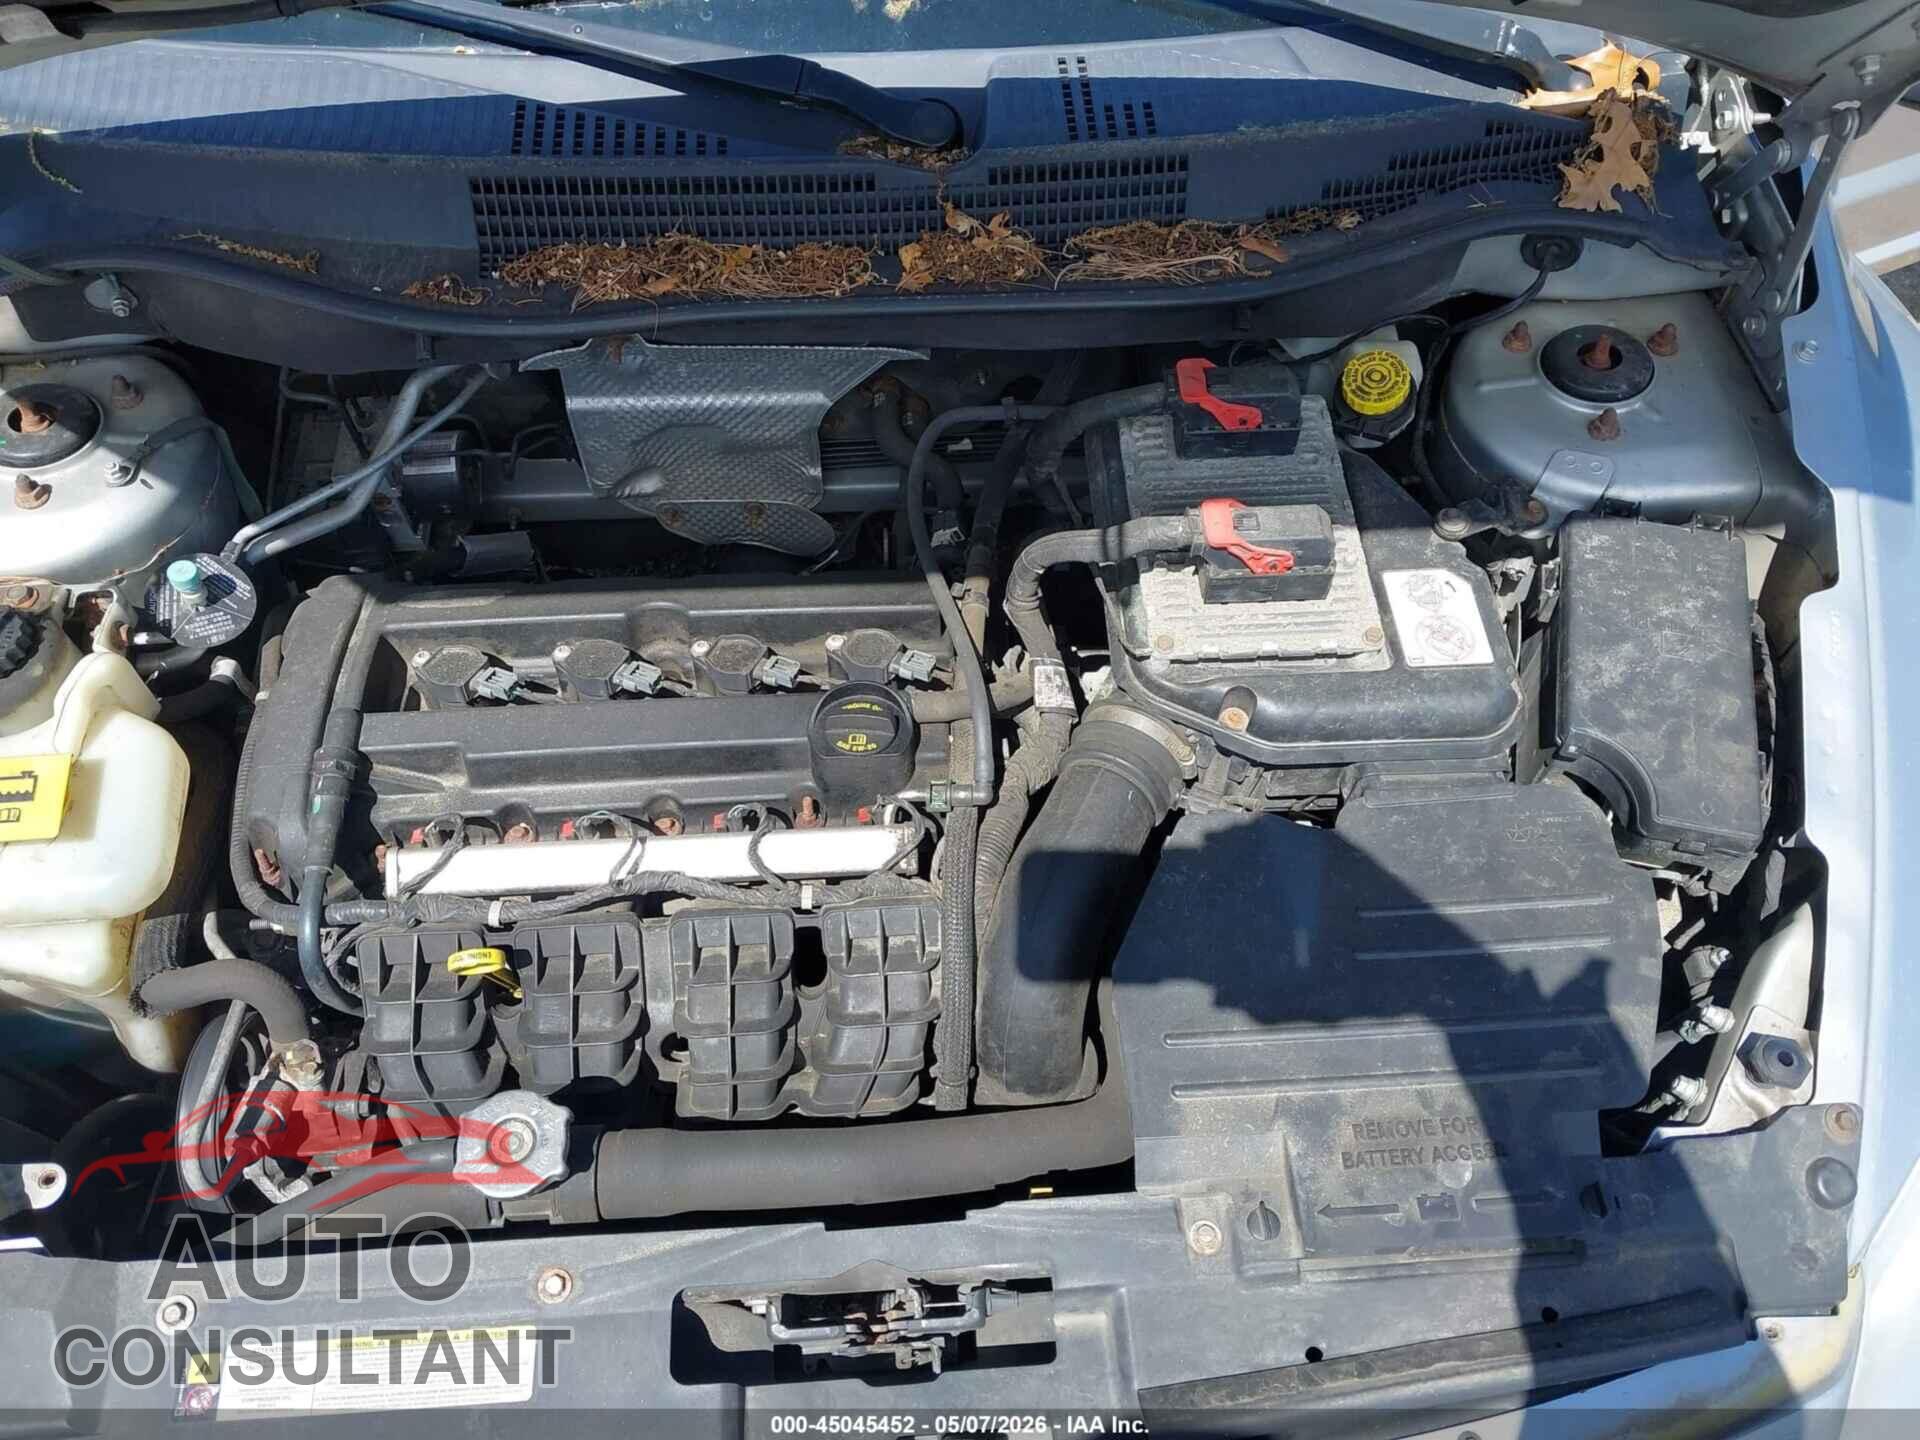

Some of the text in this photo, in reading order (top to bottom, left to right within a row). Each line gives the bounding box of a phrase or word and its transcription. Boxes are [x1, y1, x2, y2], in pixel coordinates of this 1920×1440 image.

[1351, 1115, 1481, 1142] REMOVE FOR
[1341, 1142, 1508, 1170] BATTERY ACCES
